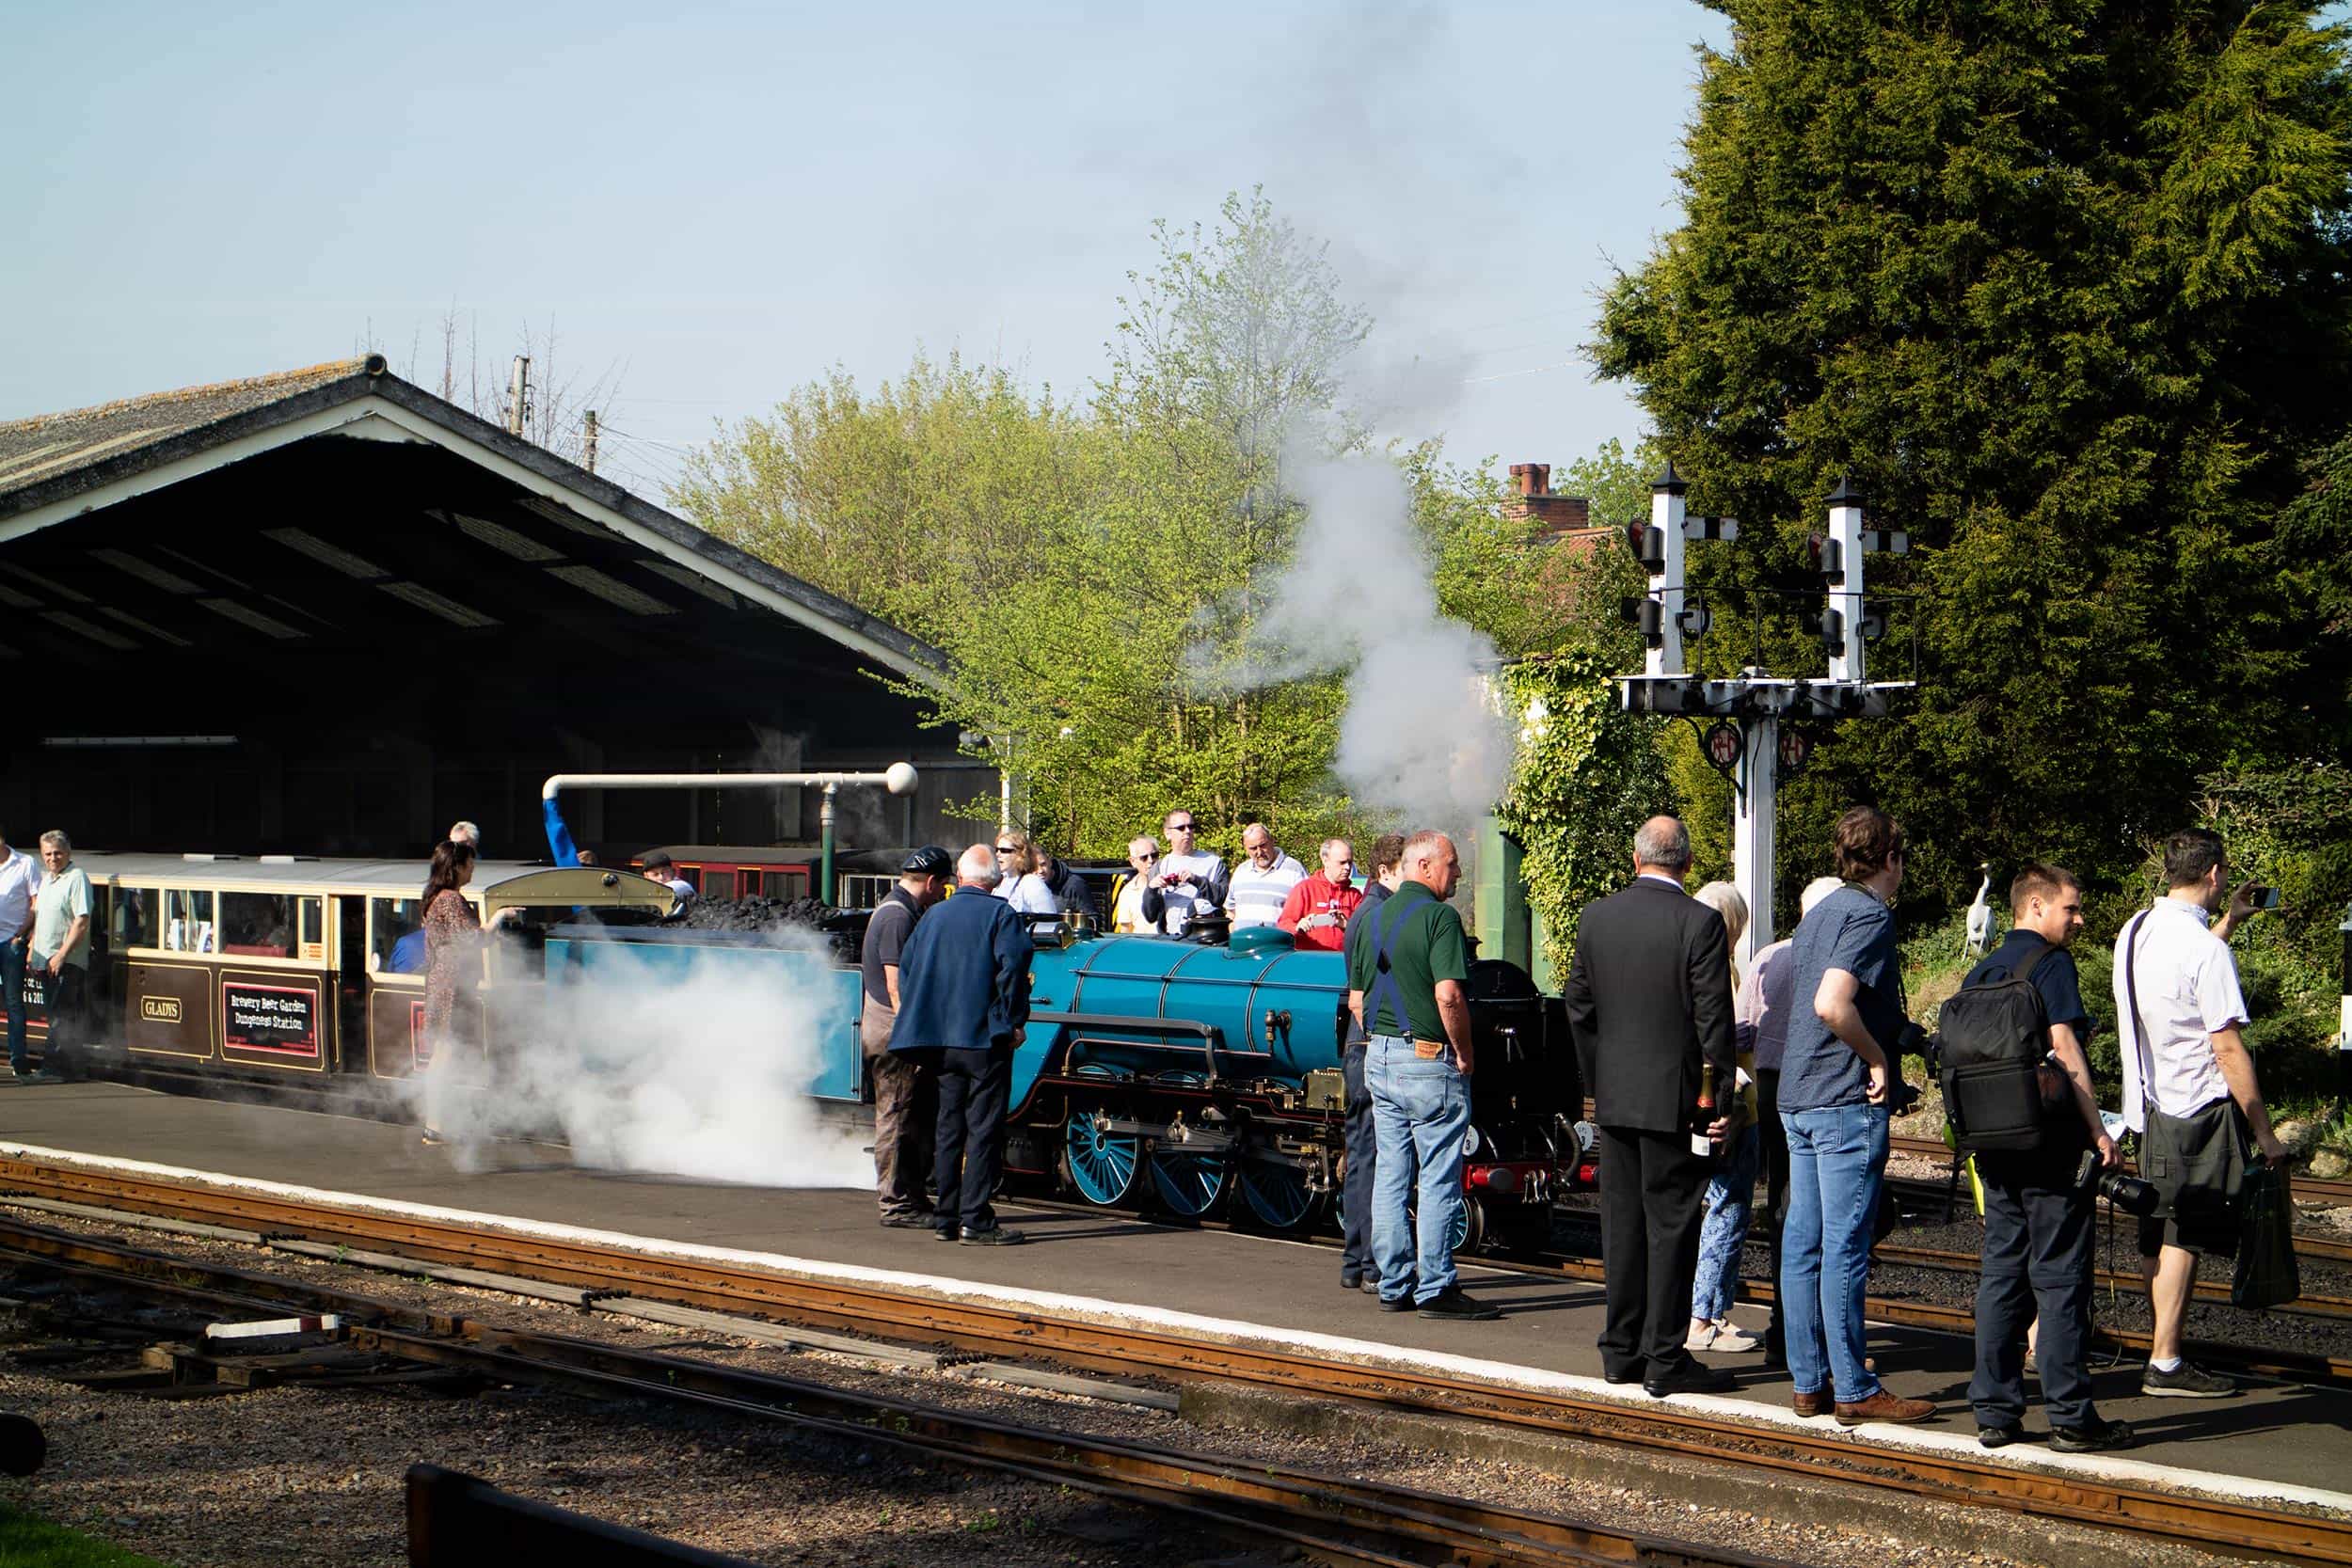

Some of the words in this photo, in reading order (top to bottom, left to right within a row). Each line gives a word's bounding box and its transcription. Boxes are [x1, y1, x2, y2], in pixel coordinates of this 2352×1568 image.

[145, 1001, 178, 1017] GLADYS
[231, 994, 261, 1012] Brewery
[262, 997, 278, 1010] Beer
[279, 999, 307, 1013] Garden
[235, 1011, 272, 1028] Dungeness
[273, 1015, 303, 1030] Station
[1465, 1139, 1470, 1150] 3
